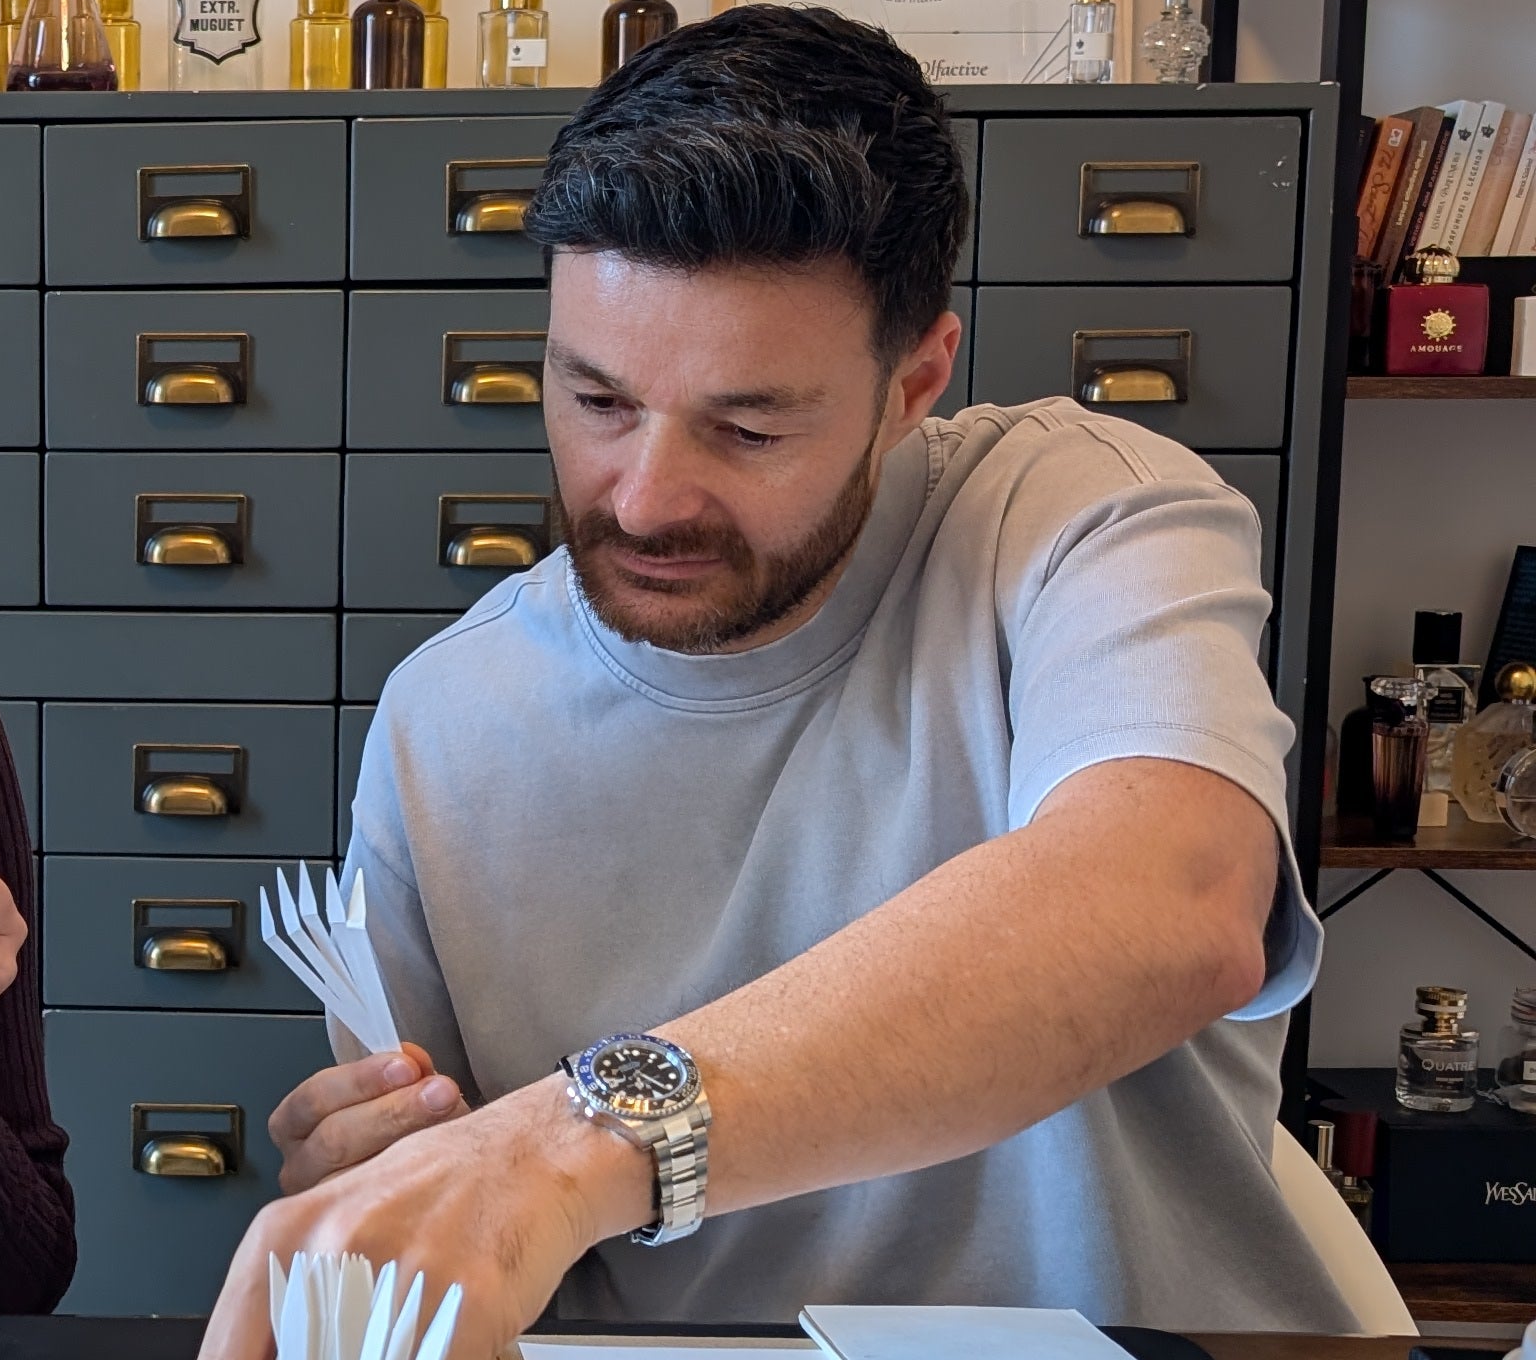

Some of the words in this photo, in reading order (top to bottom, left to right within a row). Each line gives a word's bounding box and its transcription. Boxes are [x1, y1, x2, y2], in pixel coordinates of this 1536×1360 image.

[199, 0, 240, 15] EXTR.
[189, 17, 243, 33] MUGUET
[1410, 344, 1463, 353] AMOUAGE
[1421, 1058, 1475, 1071] QUATRE
